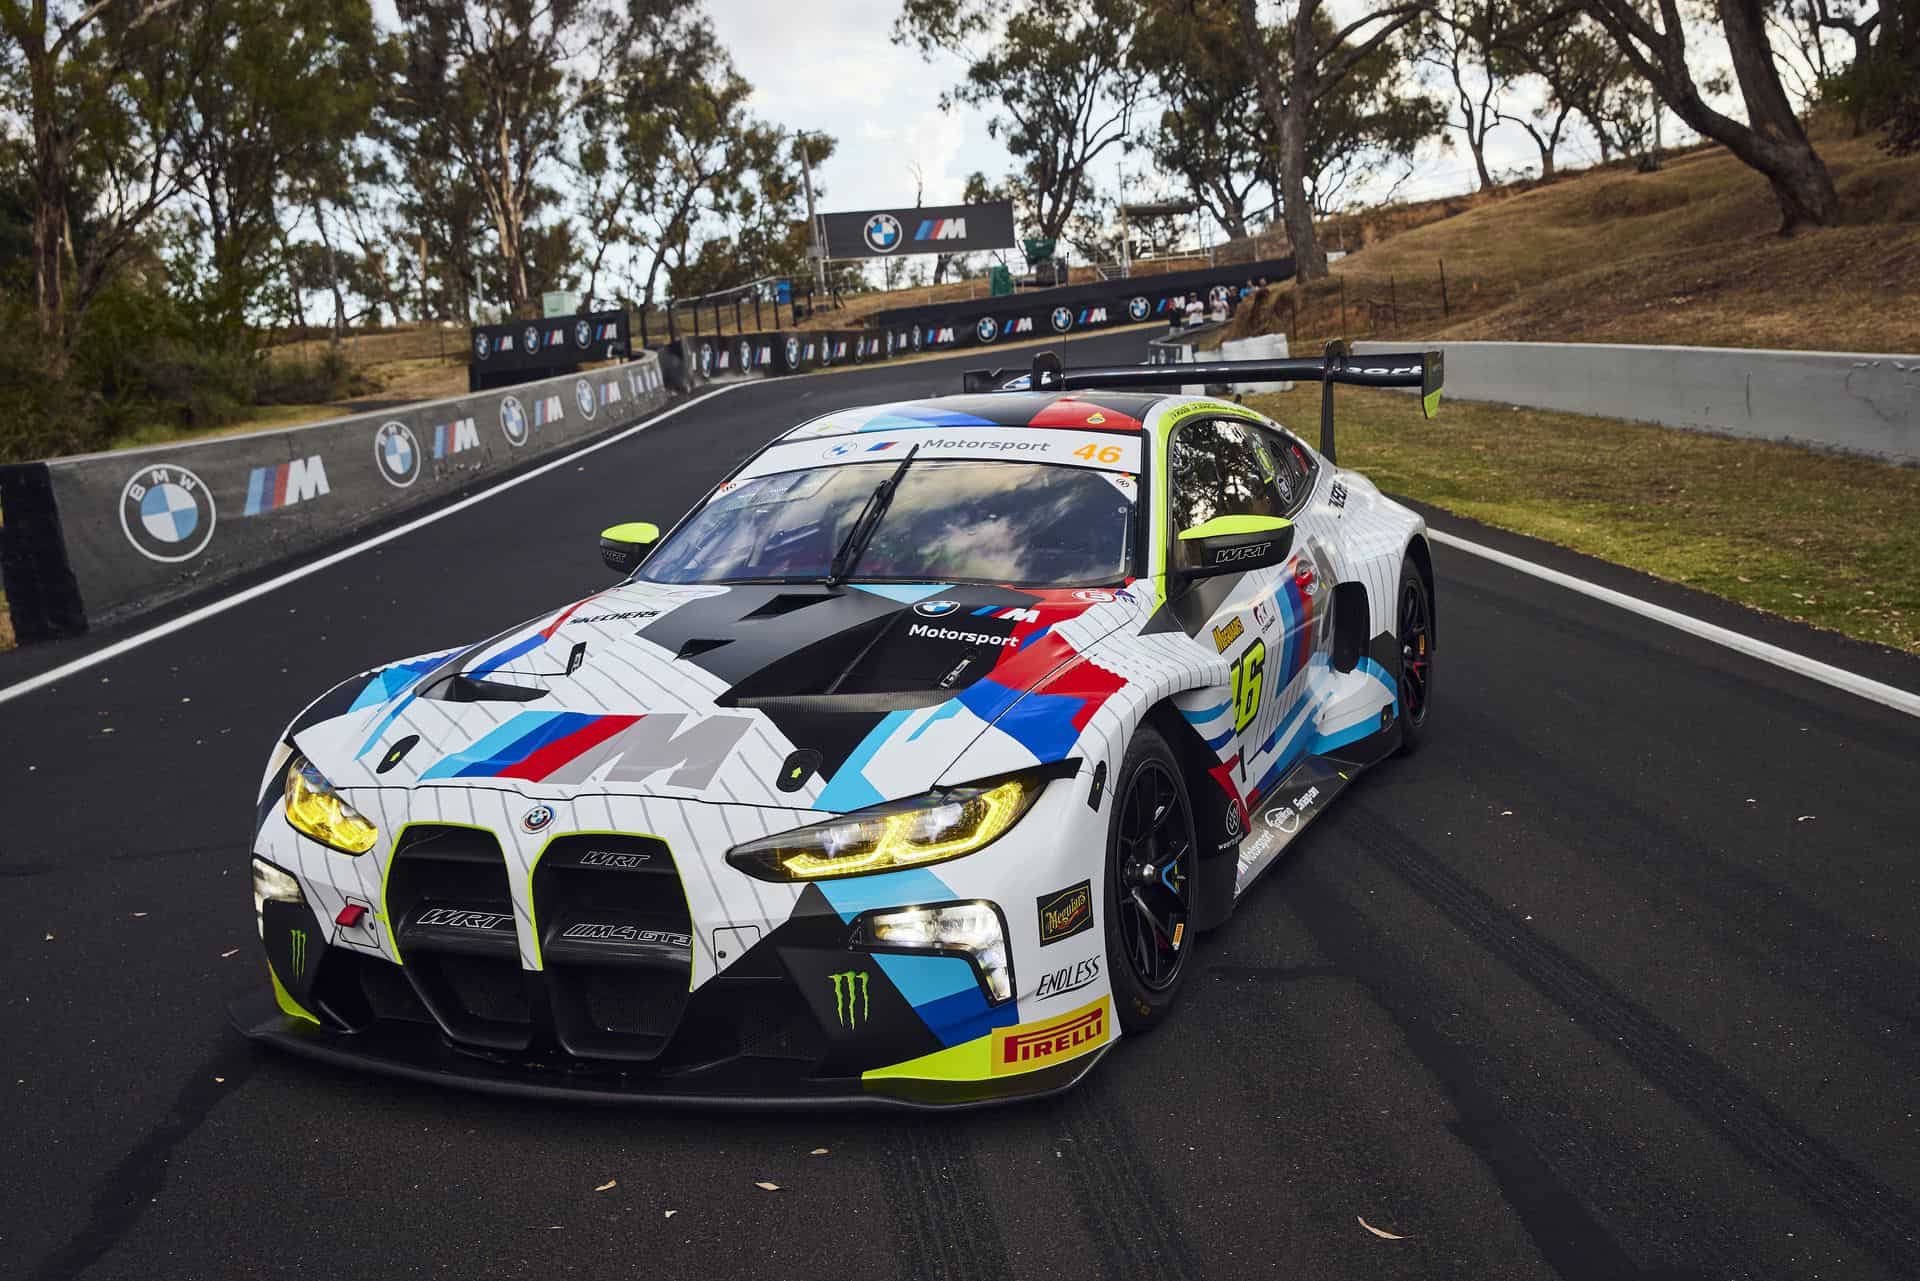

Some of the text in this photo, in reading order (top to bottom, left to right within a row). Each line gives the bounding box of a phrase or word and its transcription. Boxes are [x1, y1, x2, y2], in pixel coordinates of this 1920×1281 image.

[937, 218, 967, 239] M
[454, 417, 481, 454] M
[922, 438, 1122, 465] Motorsport 46
[129, 454, 332, 507] BMW M
[1216, 542, 1271, 563] WRT
[566, 610, 661, 626] SKECHERS
[998, 608, 1040, 623] M
[908, 623, 1019, 648] Motorsport
[540, 713, 755, 791] M
[580, 850, 651, 869] WRT
[416, 908, 514, 929] WRT
[1035, 954, 1101, 997] ENDLESS
[1003, 1008, 1103, 1064] PIRELLI
